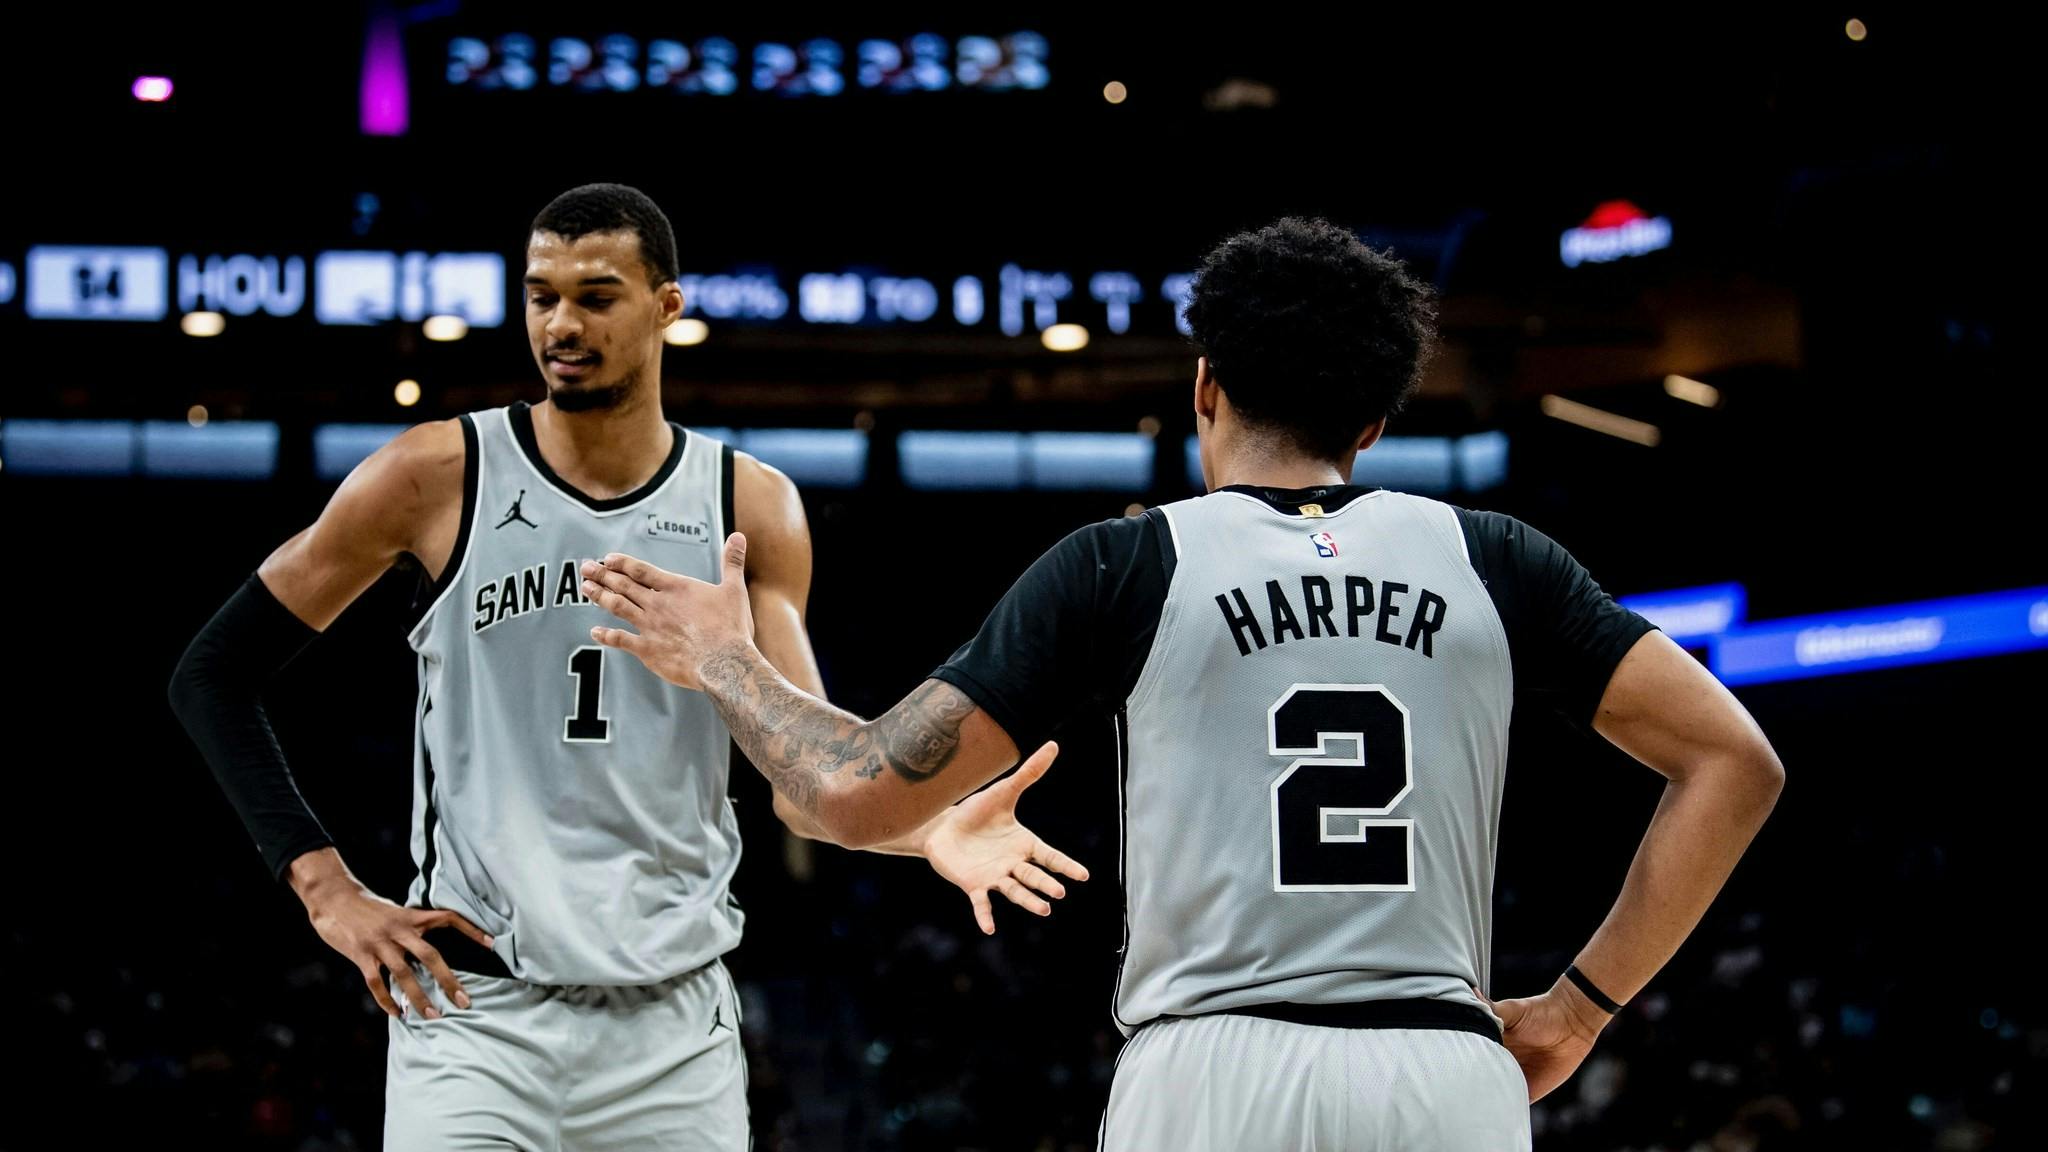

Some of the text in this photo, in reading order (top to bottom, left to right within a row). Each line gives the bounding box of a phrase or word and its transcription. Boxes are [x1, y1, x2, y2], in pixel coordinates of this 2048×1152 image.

[178, 253, 305, 317] HOU
[655, 520, 701, 537] LEDGER
[473, 563, 548, 635] SAN
[1215, 575, 1447, 659] HARPER
[563, 645, 610, 743] 1
[1268, 683, 1415, 892] 2
